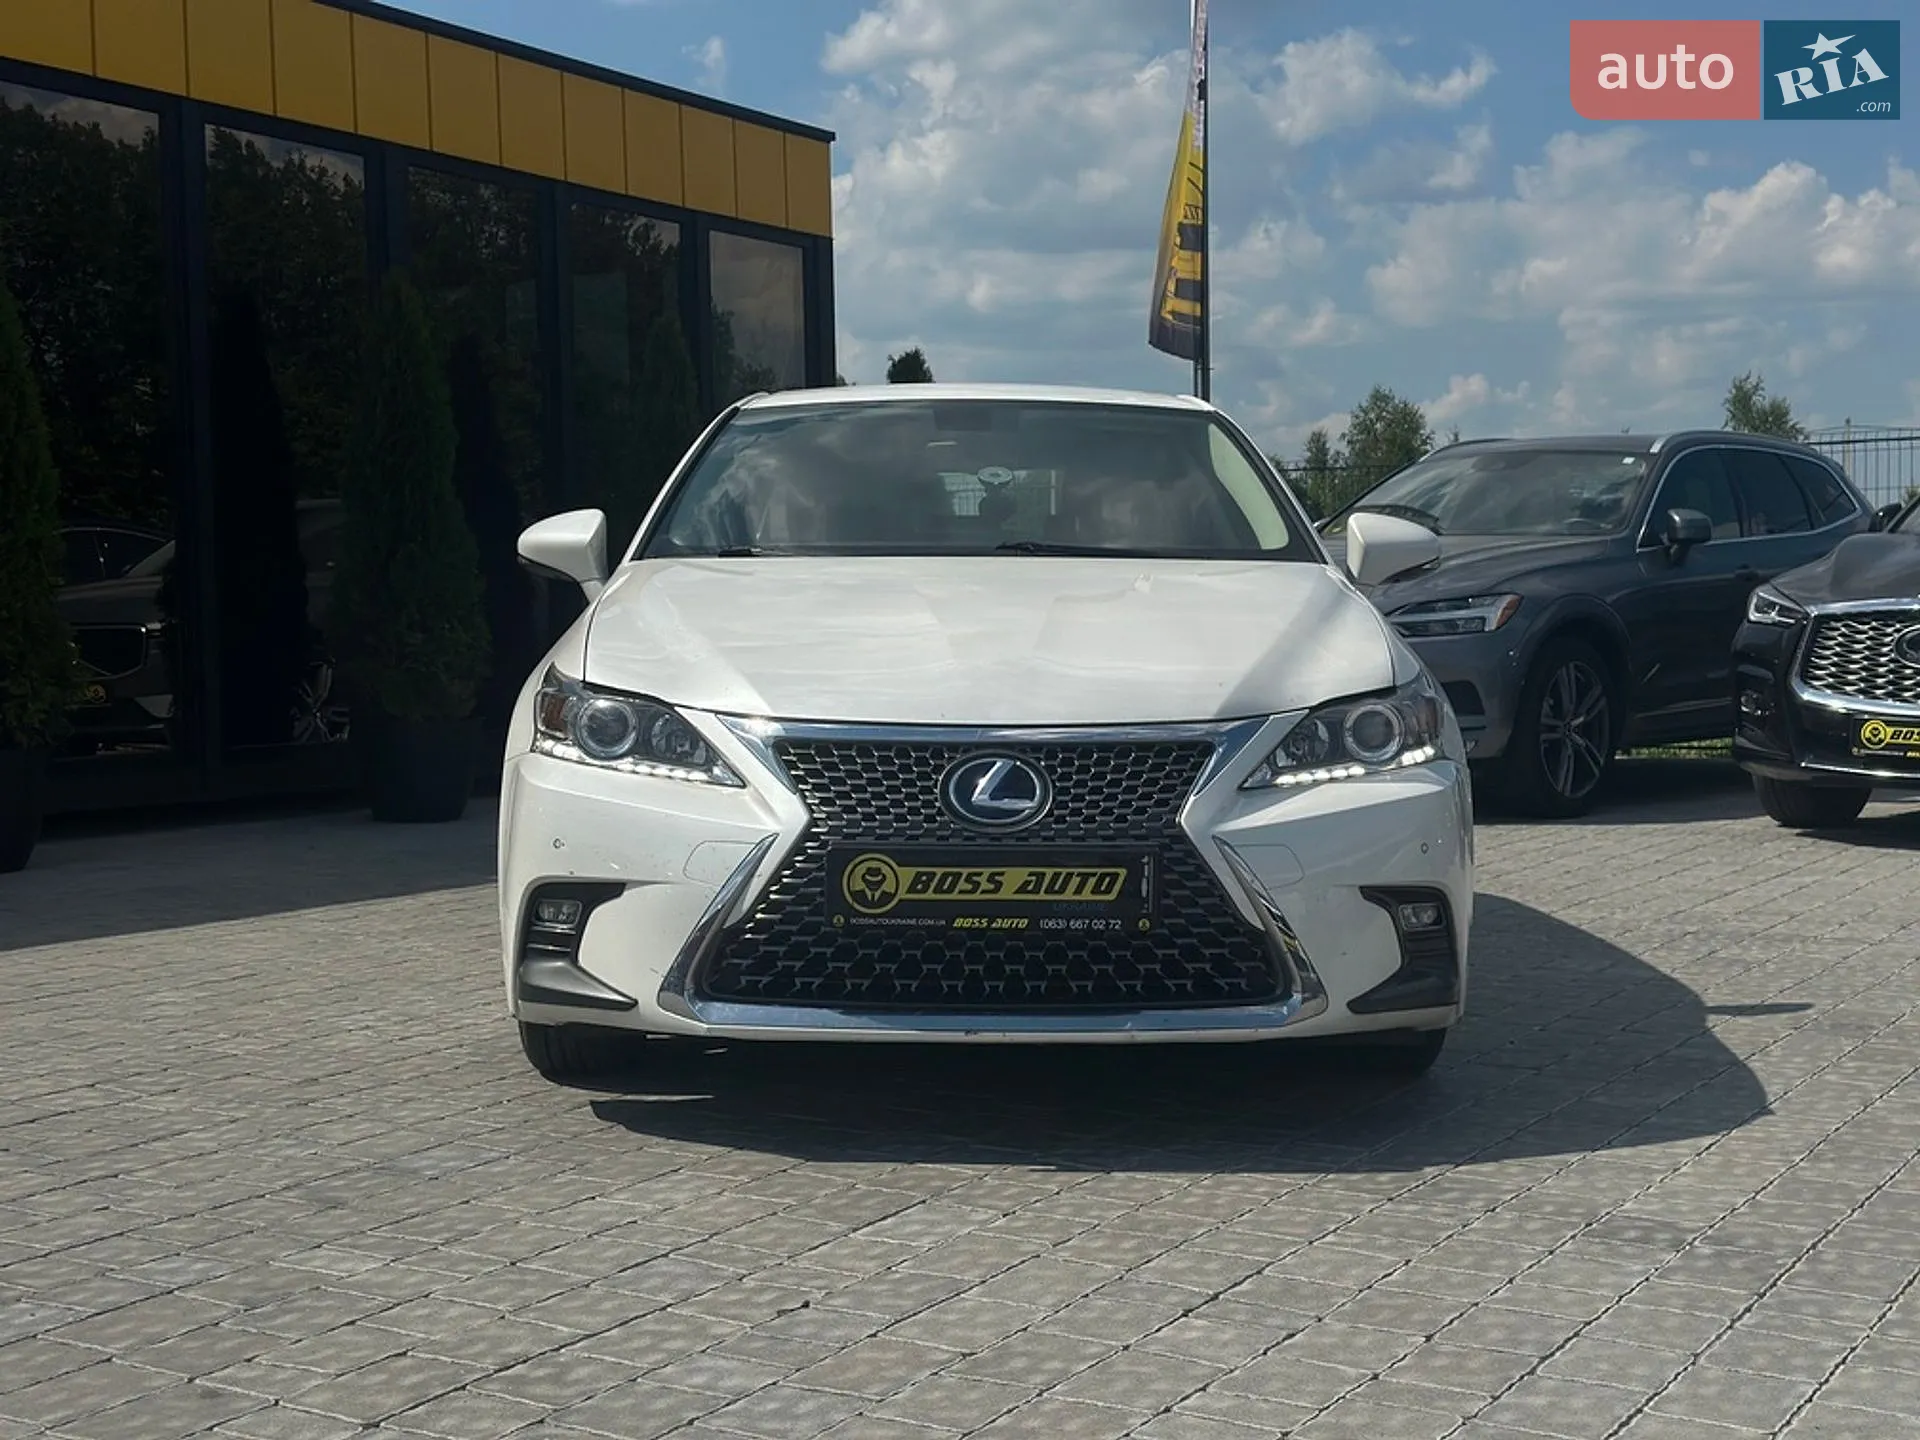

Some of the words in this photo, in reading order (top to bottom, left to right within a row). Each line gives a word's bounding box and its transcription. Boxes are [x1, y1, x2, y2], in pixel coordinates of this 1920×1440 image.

[905, 871, 1007, 894] BOSS
[1012, 872, 1122, 895] AUTO
[953, 918, 988, 928] BOSS
[990, 918, 1029, 928] AUTO
[1092, 919, 1106, 929] 02
[1108, 919, 1122, 929] 72
